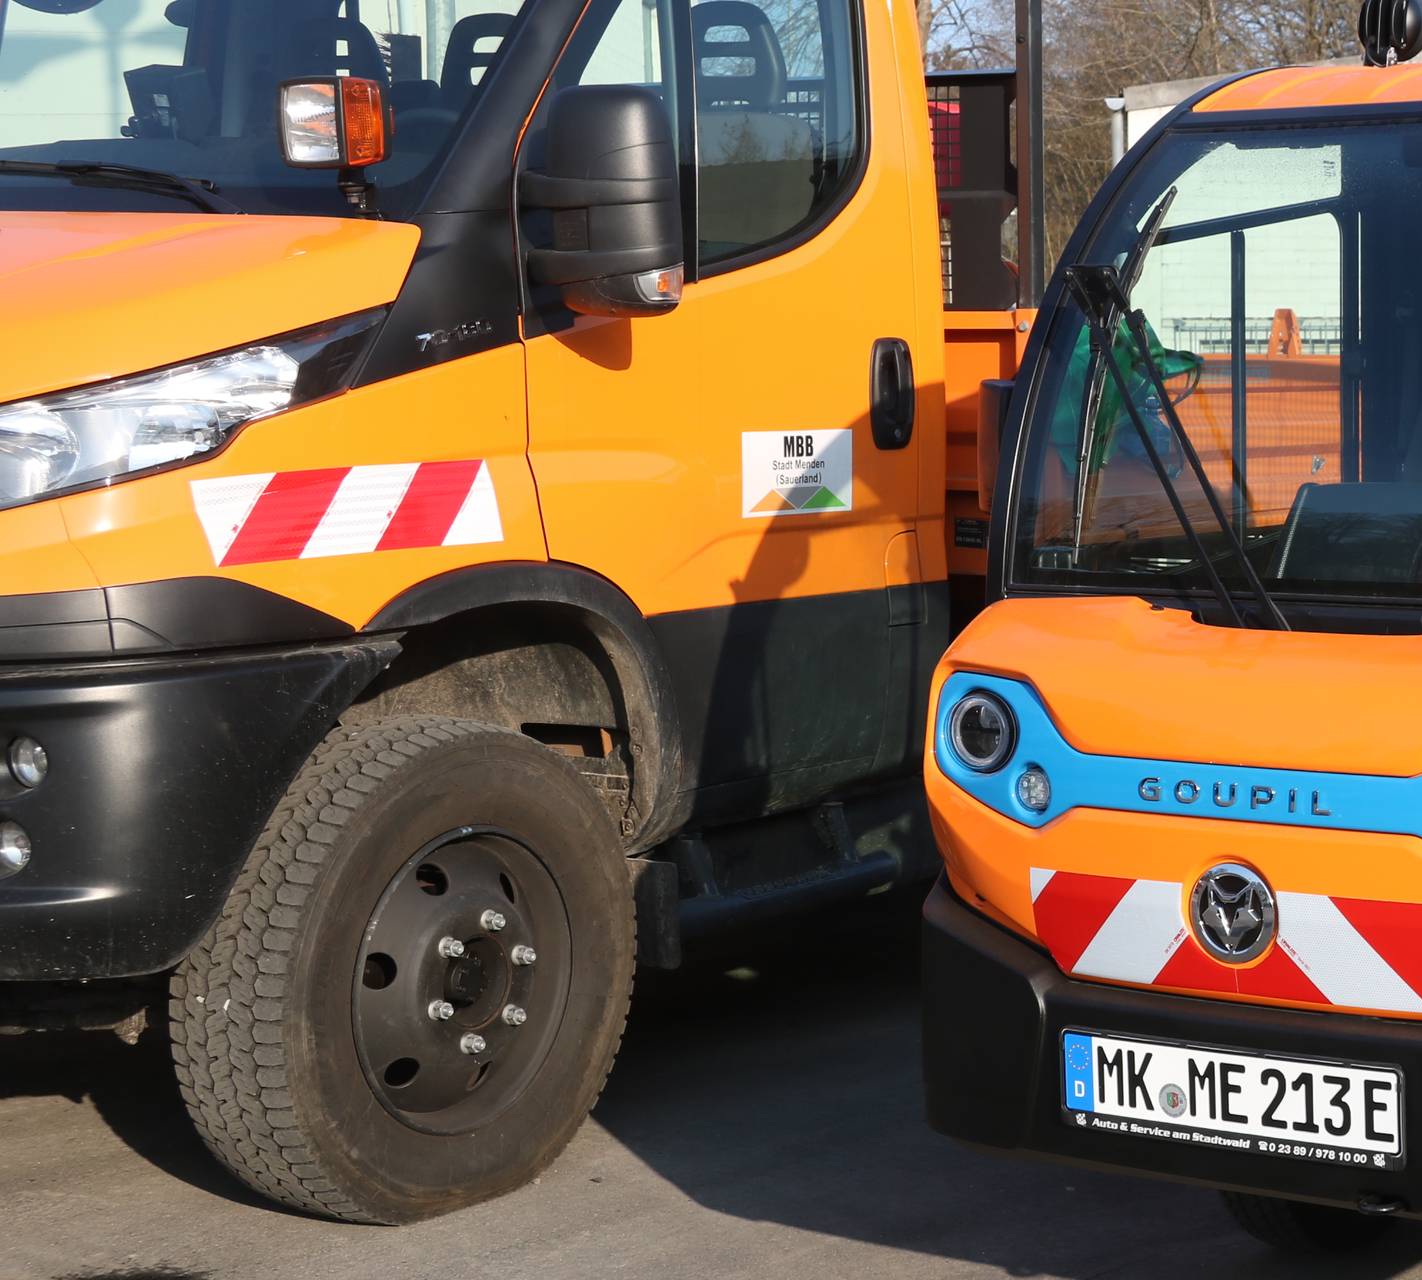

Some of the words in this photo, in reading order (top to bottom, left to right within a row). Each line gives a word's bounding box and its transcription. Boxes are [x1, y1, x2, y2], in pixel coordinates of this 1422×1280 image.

[783, 434, 814, 458] MBB
[772, 460, 793, 470] Stadt
[795, 458, 825, 470] Menden
[776, 472, 822, 485] (Sauerland)
[1138, 776, 1332, 817] GOUPIL
[1074, 1080, 1085, 1098] D
[1097, 1046, 1154, 1111] MK
[1188, 1058, 1249, 1125] ME
[1260, 1068, 1351, 1136] 213
[1092, 1117, 1118, 1130] Auto
[1120, 1122, 1128, 1132] &
[1130, 1123, 1171, 1138] Service
[1172, 1131, 1190, 1141] am
[1192, 1132, 1250, 1149] Stadtwald
[1278, 1143, 1291, 1154] 23
[1293, 1146, 1306, 1156] 89
[1308, 1147, 1314, 1157] /
[1315, 1148, 1335, 1160] 978
[1338, 1152, 1351, 1162] 10
[1353, 1153, 1367, 1164] 00
